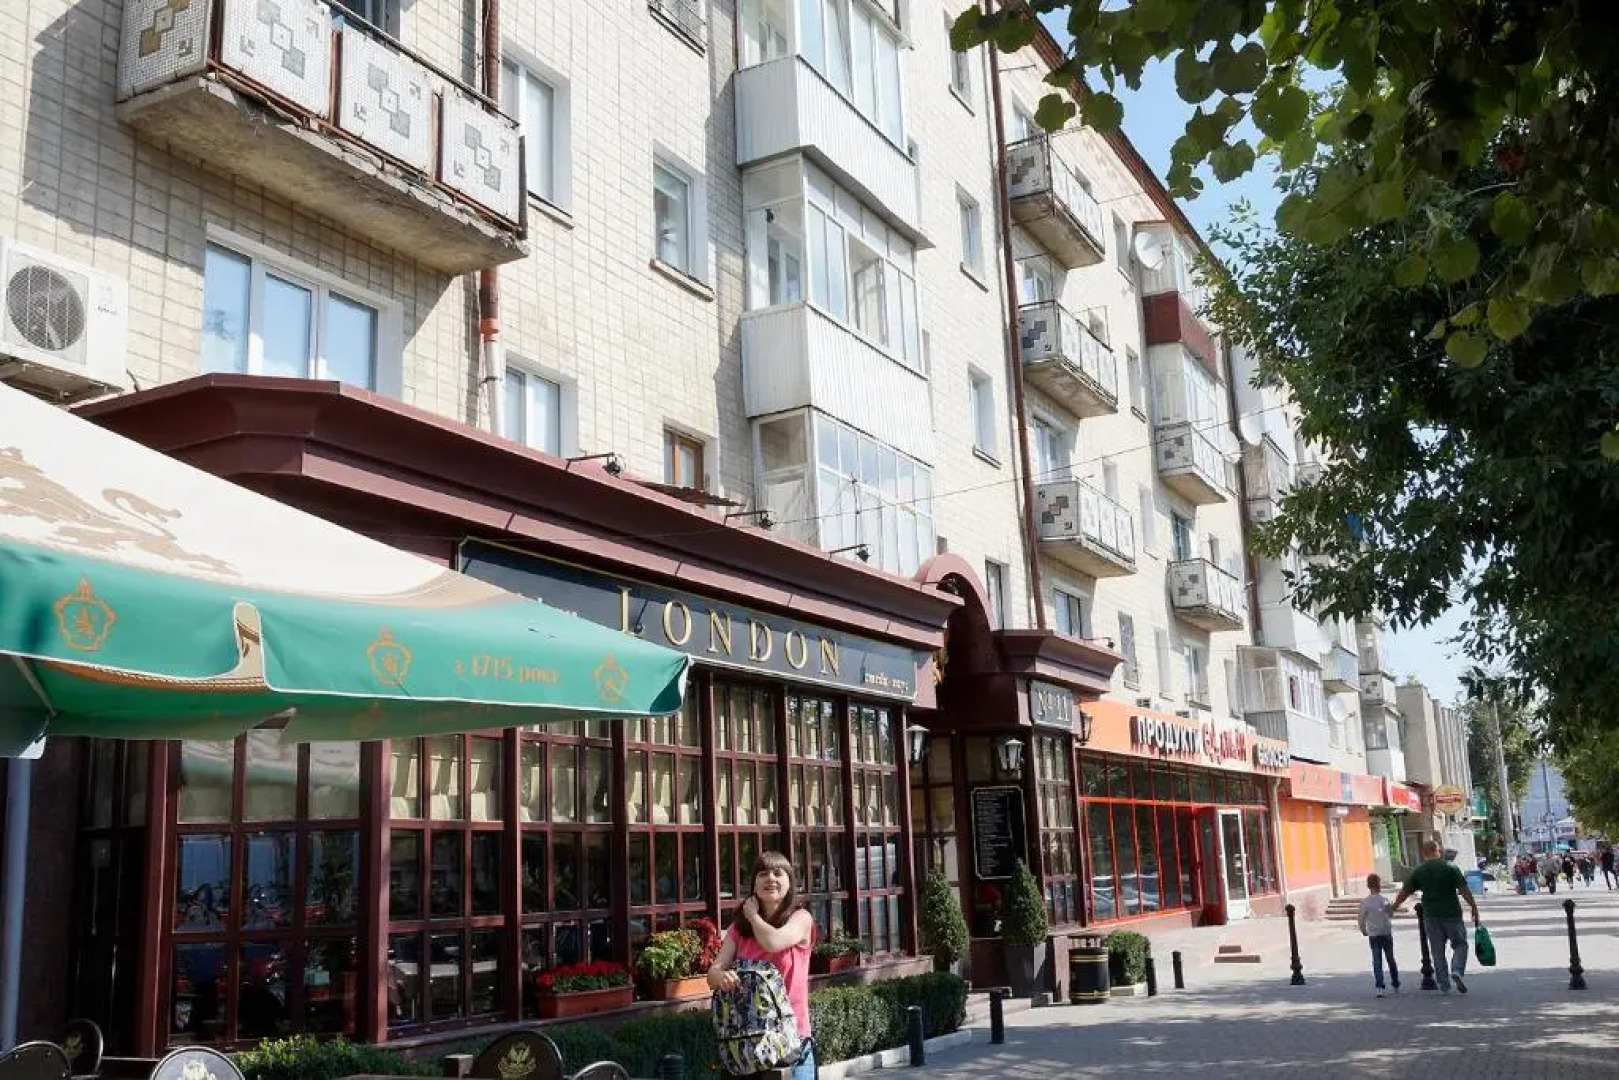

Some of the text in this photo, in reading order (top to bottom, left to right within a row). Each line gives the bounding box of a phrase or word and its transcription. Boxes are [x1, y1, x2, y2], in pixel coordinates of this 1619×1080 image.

[618, 585, 839, 677] LONDON
[471, 654, 514, 680] 1715
[1131, 715, 1203, 755] ПРОДУКТИ
